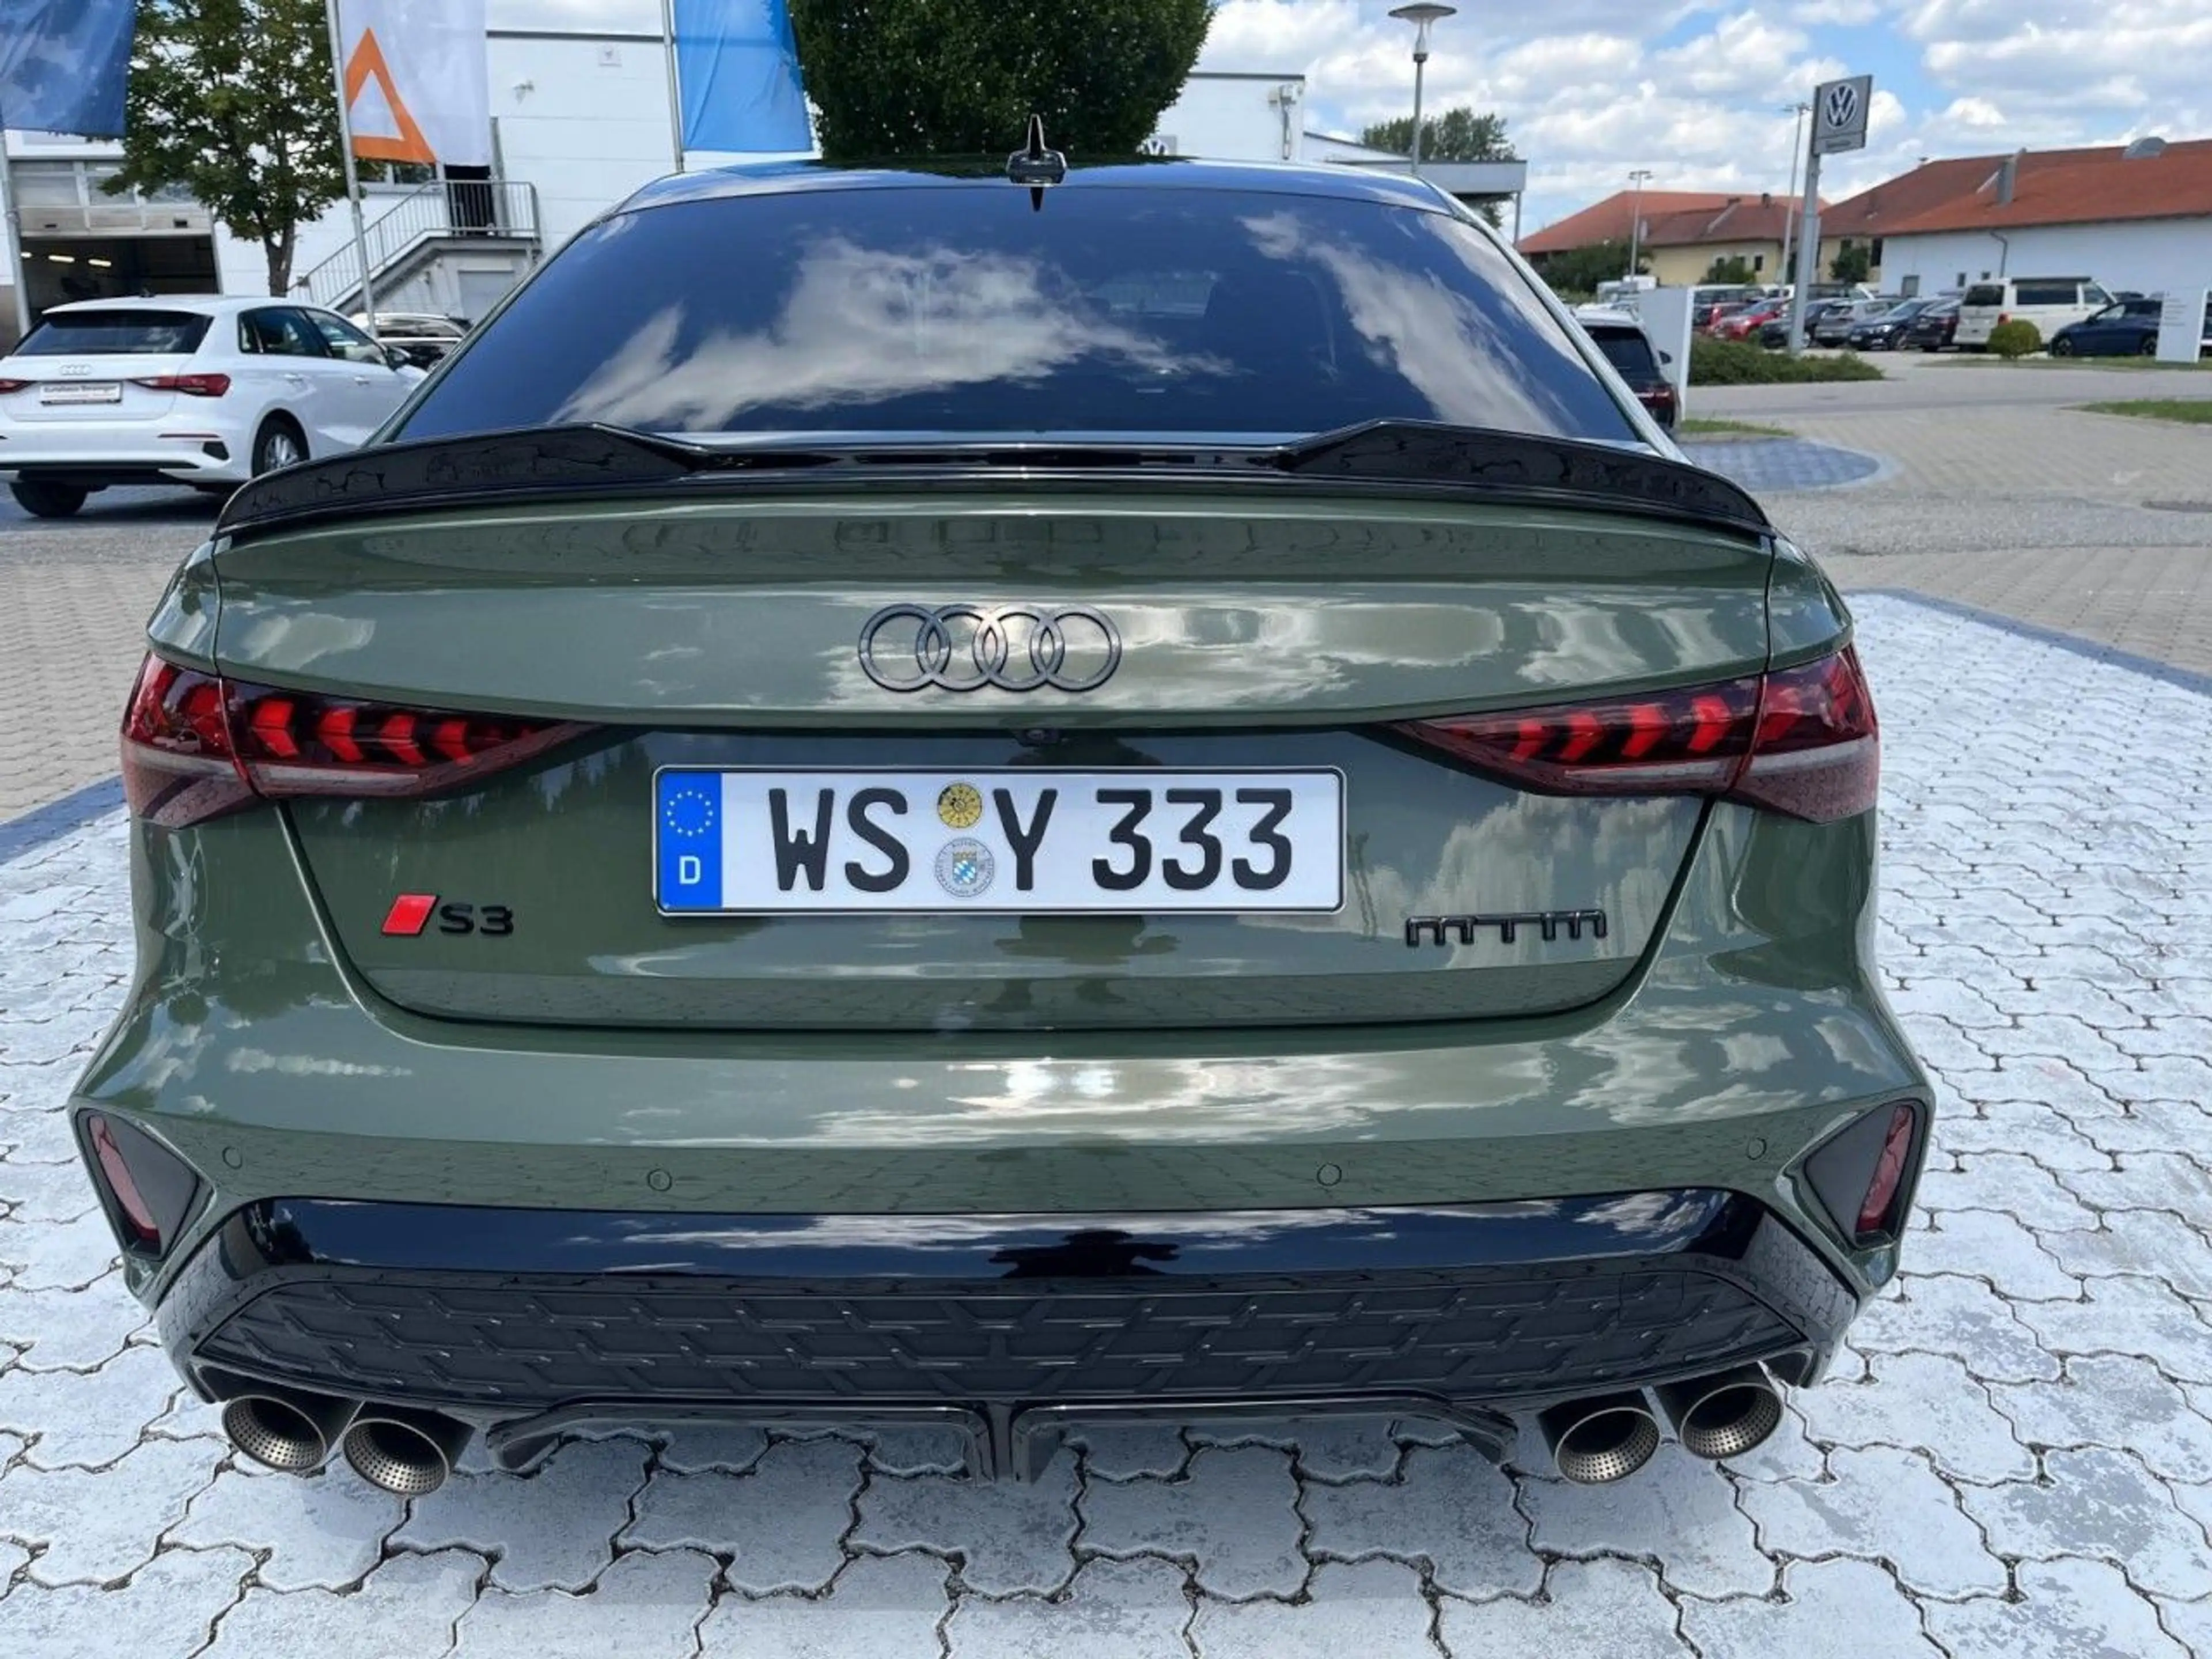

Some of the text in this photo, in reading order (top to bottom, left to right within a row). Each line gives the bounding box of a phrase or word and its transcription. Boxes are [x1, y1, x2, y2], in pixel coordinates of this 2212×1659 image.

[1825, 83, 1858, 128] VW
[768, 787, 910, 893] WS
[993, 787, 1058, 891] Y
[1092, 787, 1292, 891] 333
[679, 855, 701, 885] D
[440, 903, 514, 935] S3
